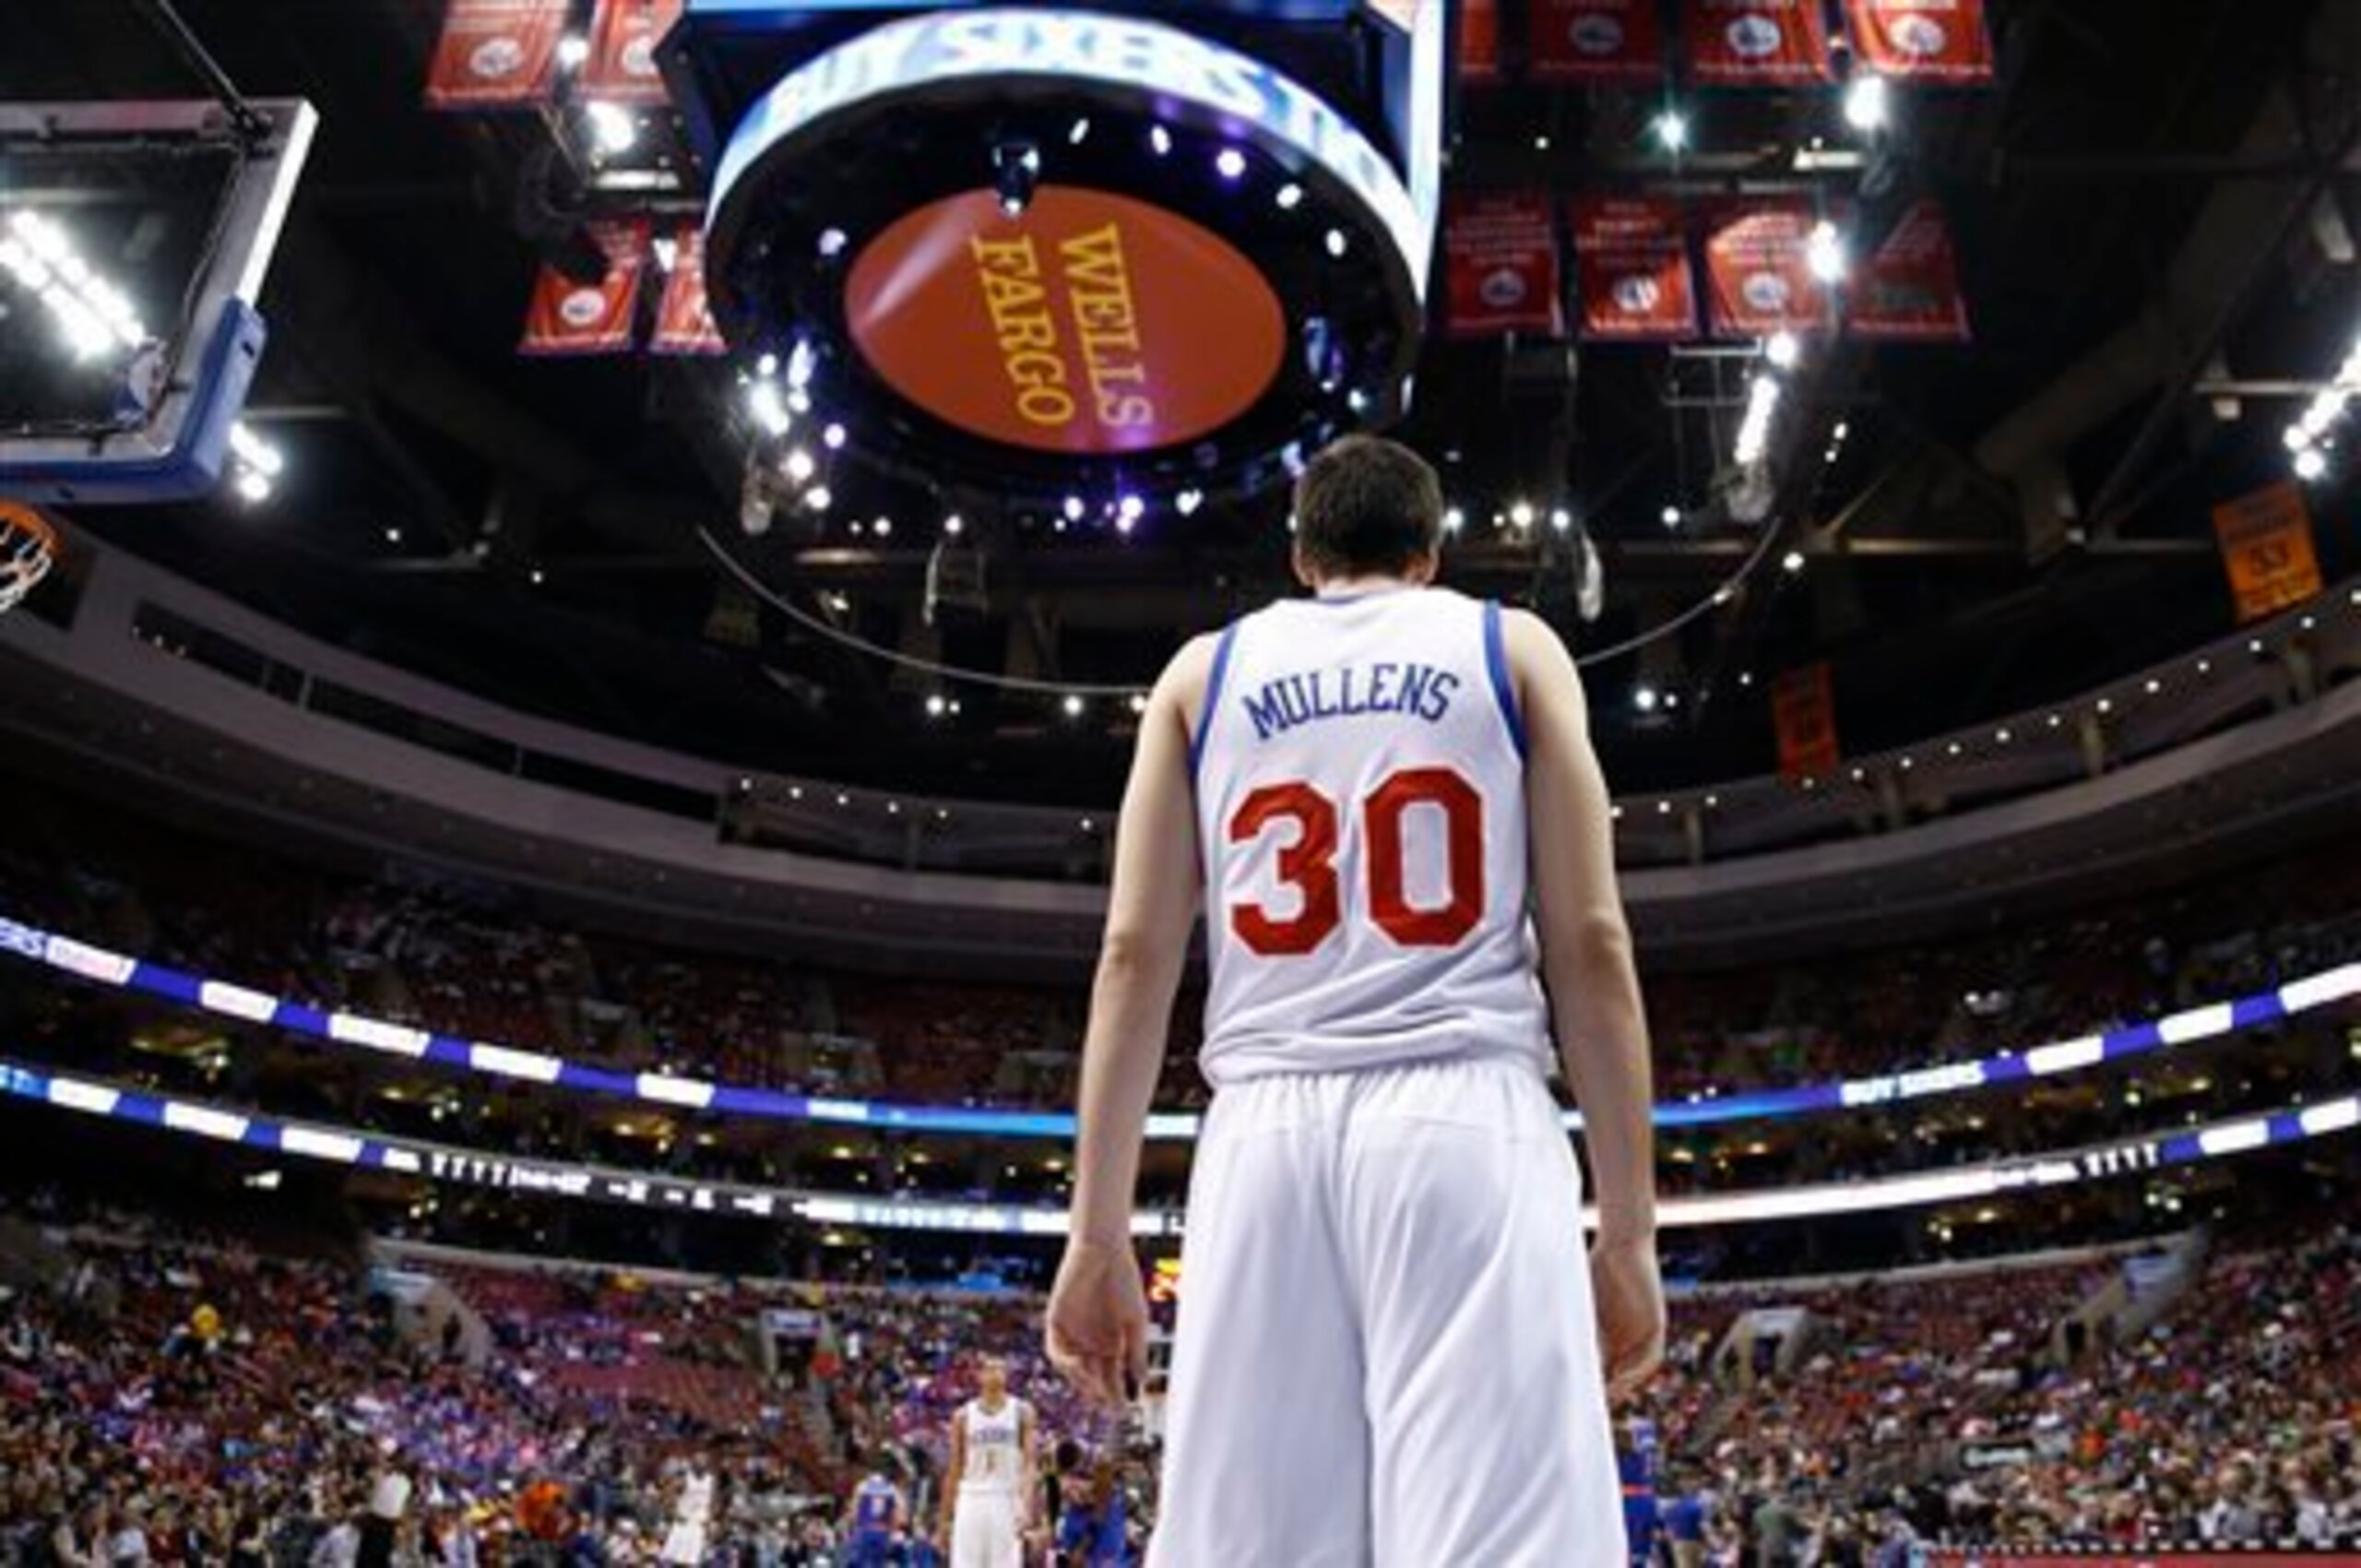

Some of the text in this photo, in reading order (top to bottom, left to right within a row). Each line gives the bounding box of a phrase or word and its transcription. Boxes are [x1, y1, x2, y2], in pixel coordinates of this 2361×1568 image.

[941, 11, 1269, 118] SIXERS
[968, 233, 1076, 427] FARGO
[1058, 222, 1155, 430] WELLS
[1240, 662, 1461, 742] MULLENS
[1227, 766, 1487, 956] 30
